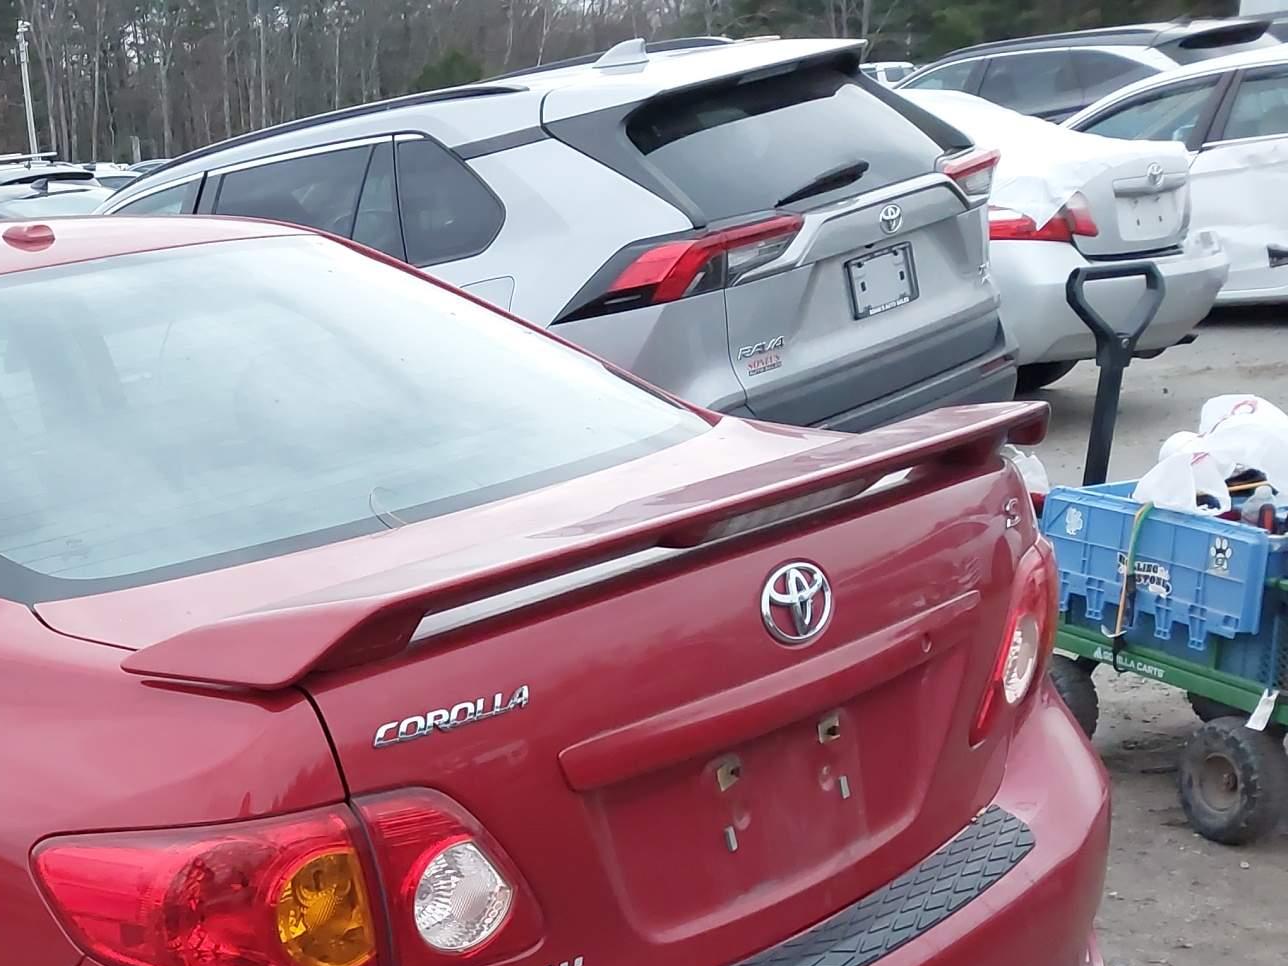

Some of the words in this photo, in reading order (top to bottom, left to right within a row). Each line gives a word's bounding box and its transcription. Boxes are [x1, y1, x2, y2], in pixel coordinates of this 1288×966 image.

[737, 335, 784, 360] RAV4
[1005, 498, 1022, 529] S
[1102, 650, 1135, 668] GOILLA
[373, 685, 530, 748] COROLLA
